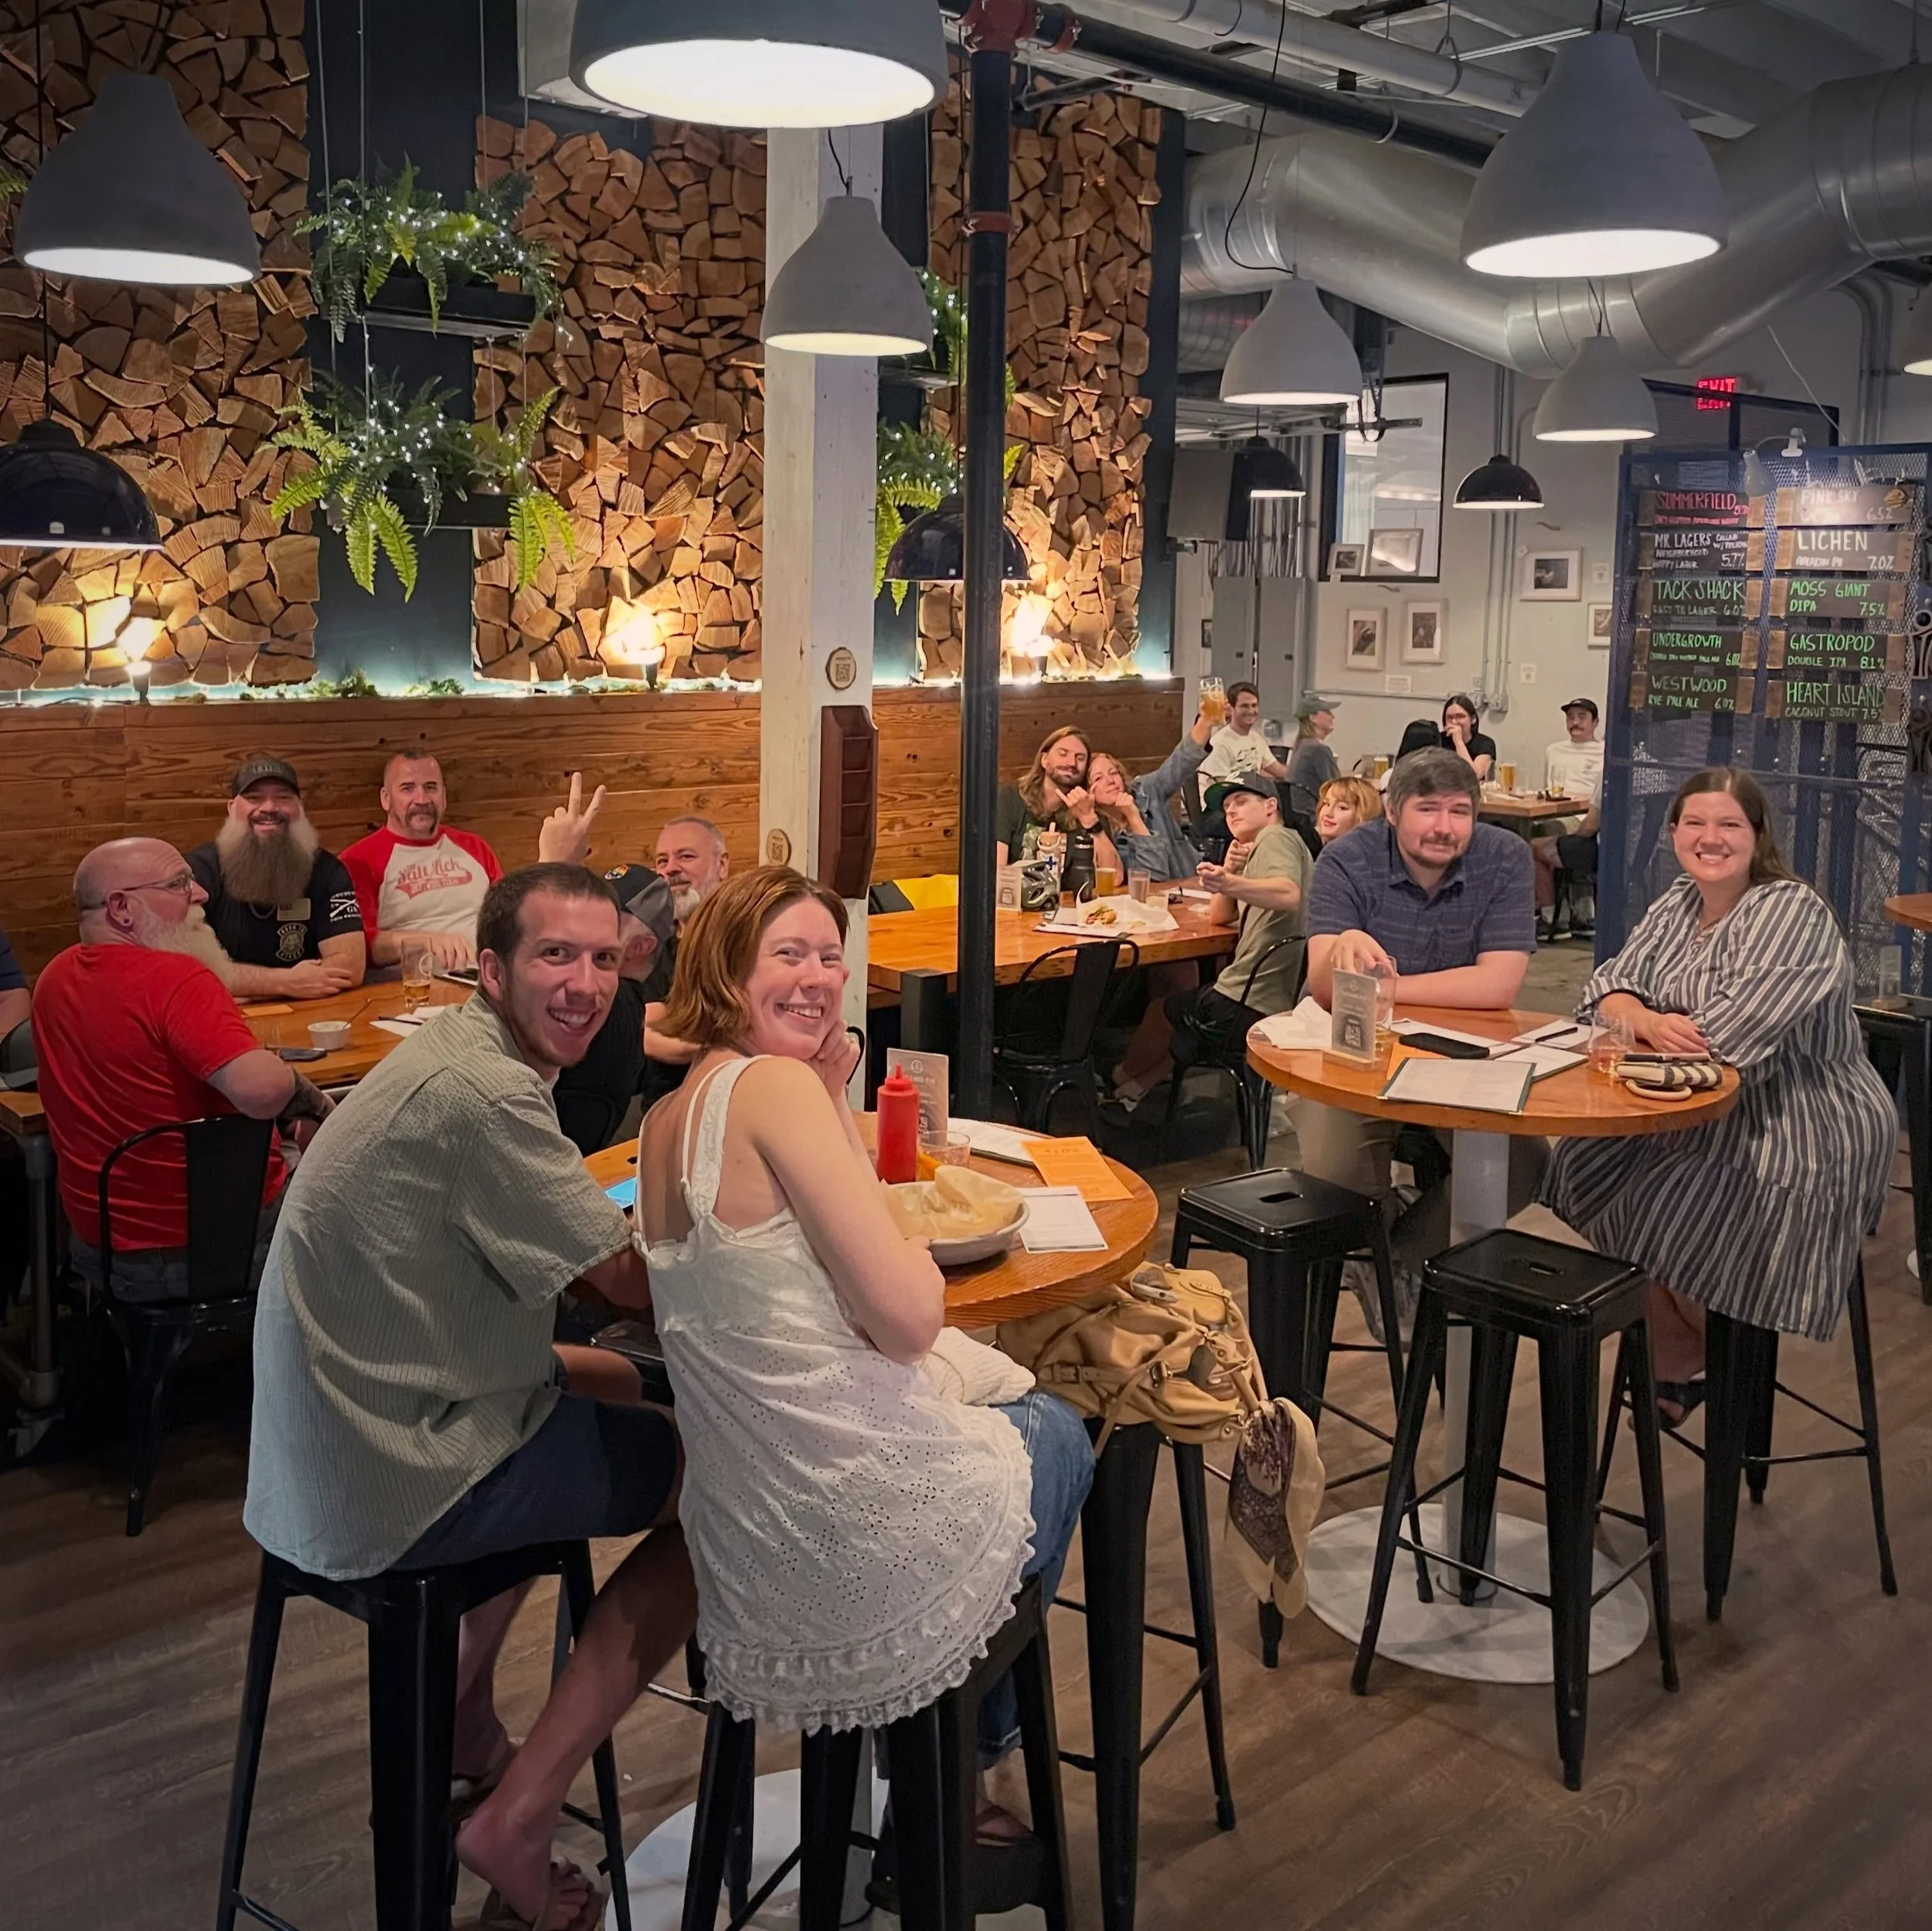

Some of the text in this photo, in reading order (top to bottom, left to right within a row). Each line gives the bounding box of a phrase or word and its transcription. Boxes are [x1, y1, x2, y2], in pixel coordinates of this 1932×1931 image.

[1655, 492, 1736, 510] SUMMERFIELD
[1801, 489, 1859, 505] PINK SKY
[1675, 533, 1711, 548] LAGERS
[1797, 530, 1868, 552] LICHEN
[1721, 552, 1745, 567] 5.7%
[1866, 555, 1895, 570] 7.0%
[1655, 580, 1746, 601] TACK SHACK
[1790, 580, 1870, 597] MOSS GIANT
[1789, 599, 1817, 613] DIPA
[1859, 601, 1886, 616] 7.5%
[1652, 632, 1722, 648] UNDERGROWTH
[1790, 634, 1875, 653] GASTROPOD
[1787, 655, 1846, 668] DOUBLE IPA
[1651, 675, 1727, 693] WESTWOOD
[1786, 681, 1886, 708] HEART ISLAND
[1784, 706, 1858, 718] COCONUT STOUT
